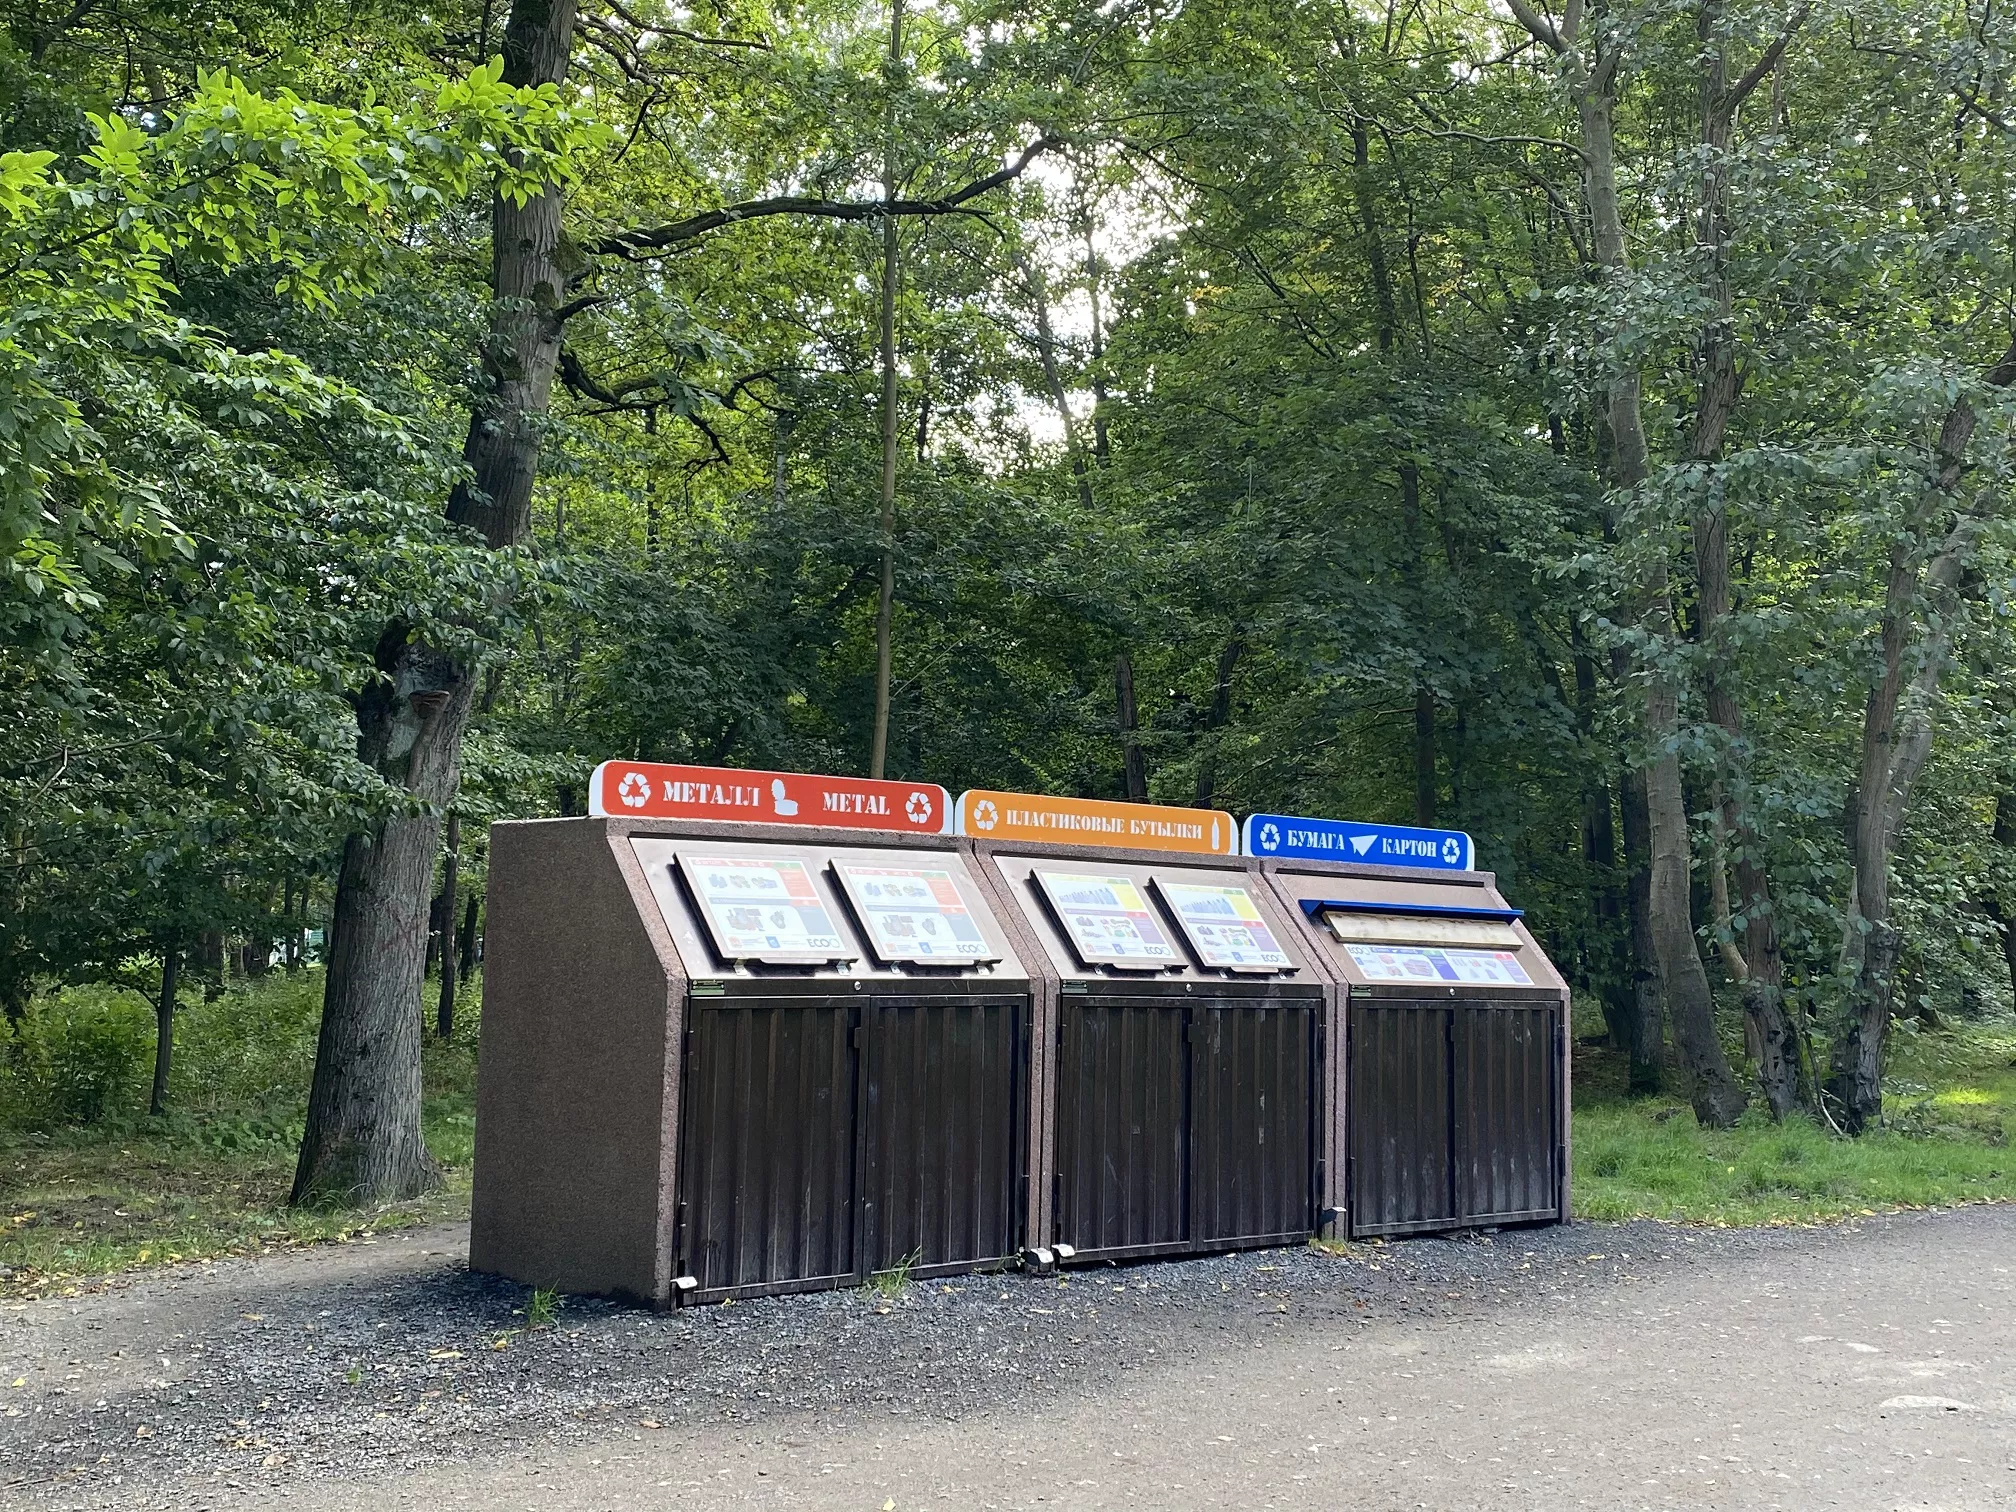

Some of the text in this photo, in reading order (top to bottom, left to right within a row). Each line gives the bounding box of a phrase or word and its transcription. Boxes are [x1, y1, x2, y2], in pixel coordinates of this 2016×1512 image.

[662, 780, 761, 807] МЕТАЛЛ
[822, 792, 891, 816] METAL
[1006, 809, 1203, 840] ПЛАСТИКОВЫЕ БУТЫЛКИ
[1287, 829, 1437, 858] БУМАГА КАРТОН
